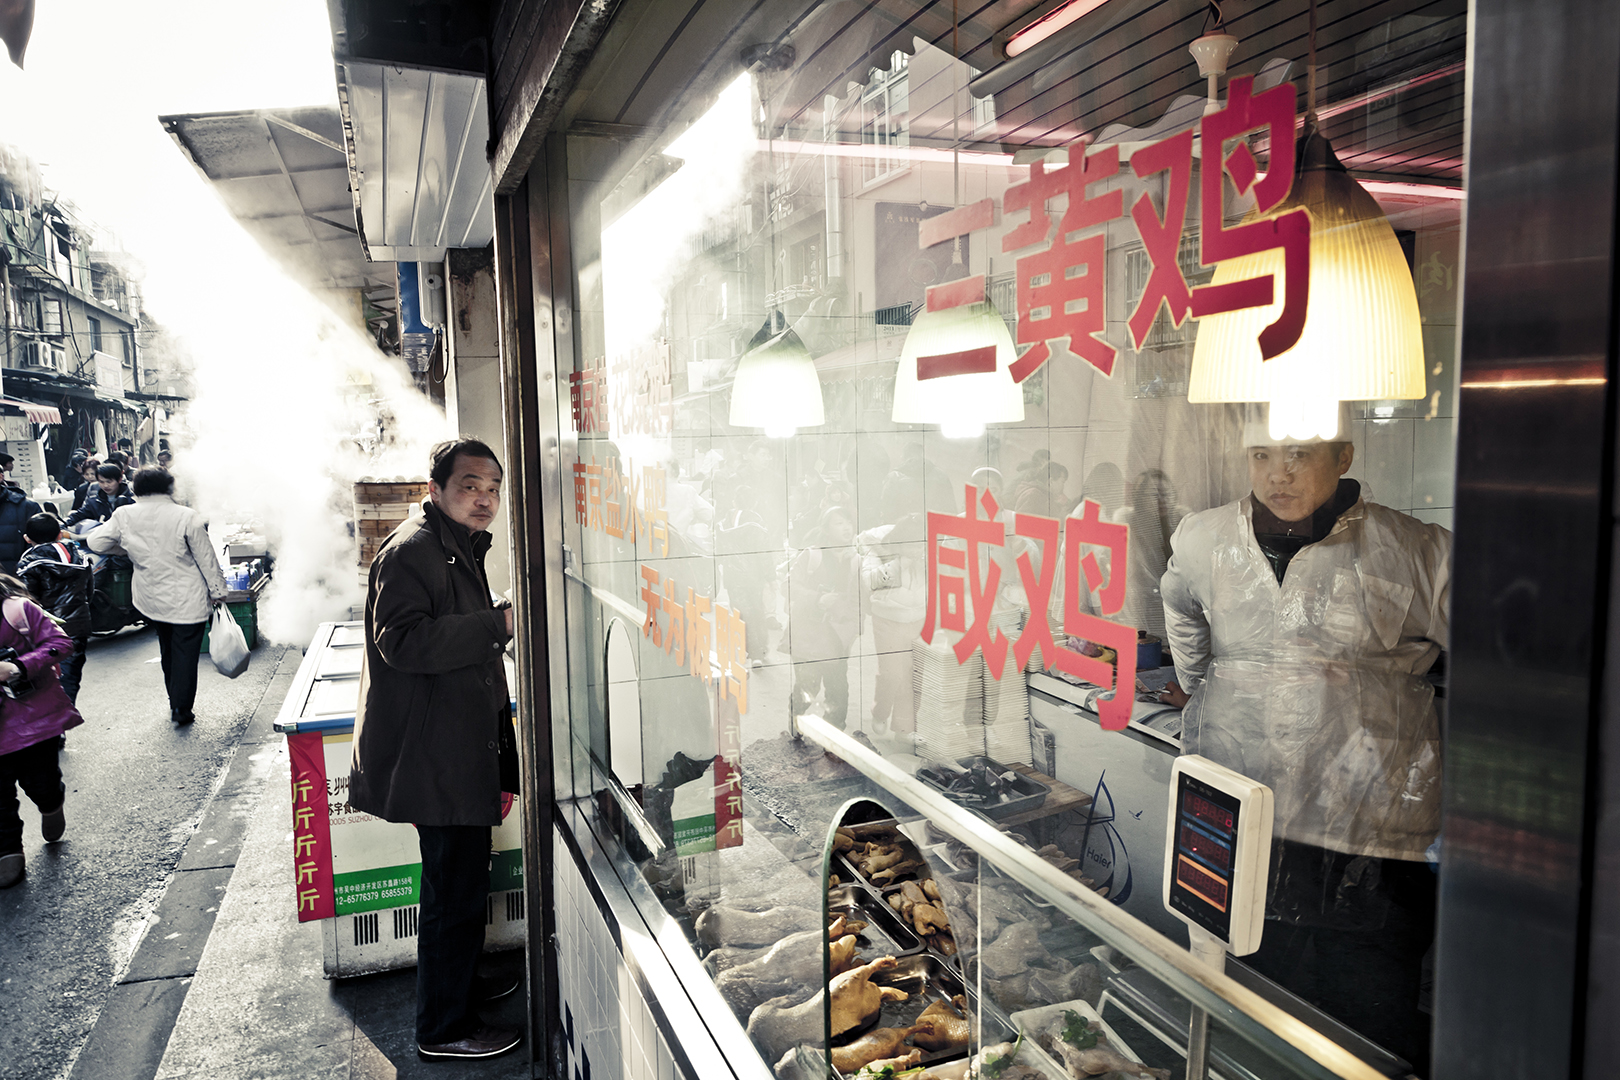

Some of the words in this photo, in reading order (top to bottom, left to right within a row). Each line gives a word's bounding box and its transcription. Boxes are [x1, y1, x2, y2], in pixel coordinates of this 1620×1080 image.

[917, 75, 1311, 382] 三黄鸡
[573, 456, 669, 558] 南京盐水鸭
[641, 564, 748, 715] 无为板鸭
[920, 484, 1137, 731] 咸鸡
[348, 814, 373, 825] SUZHOU
[1086, 846, 1113, 869] Haier
[381, 886, 413, 899] 65855379
